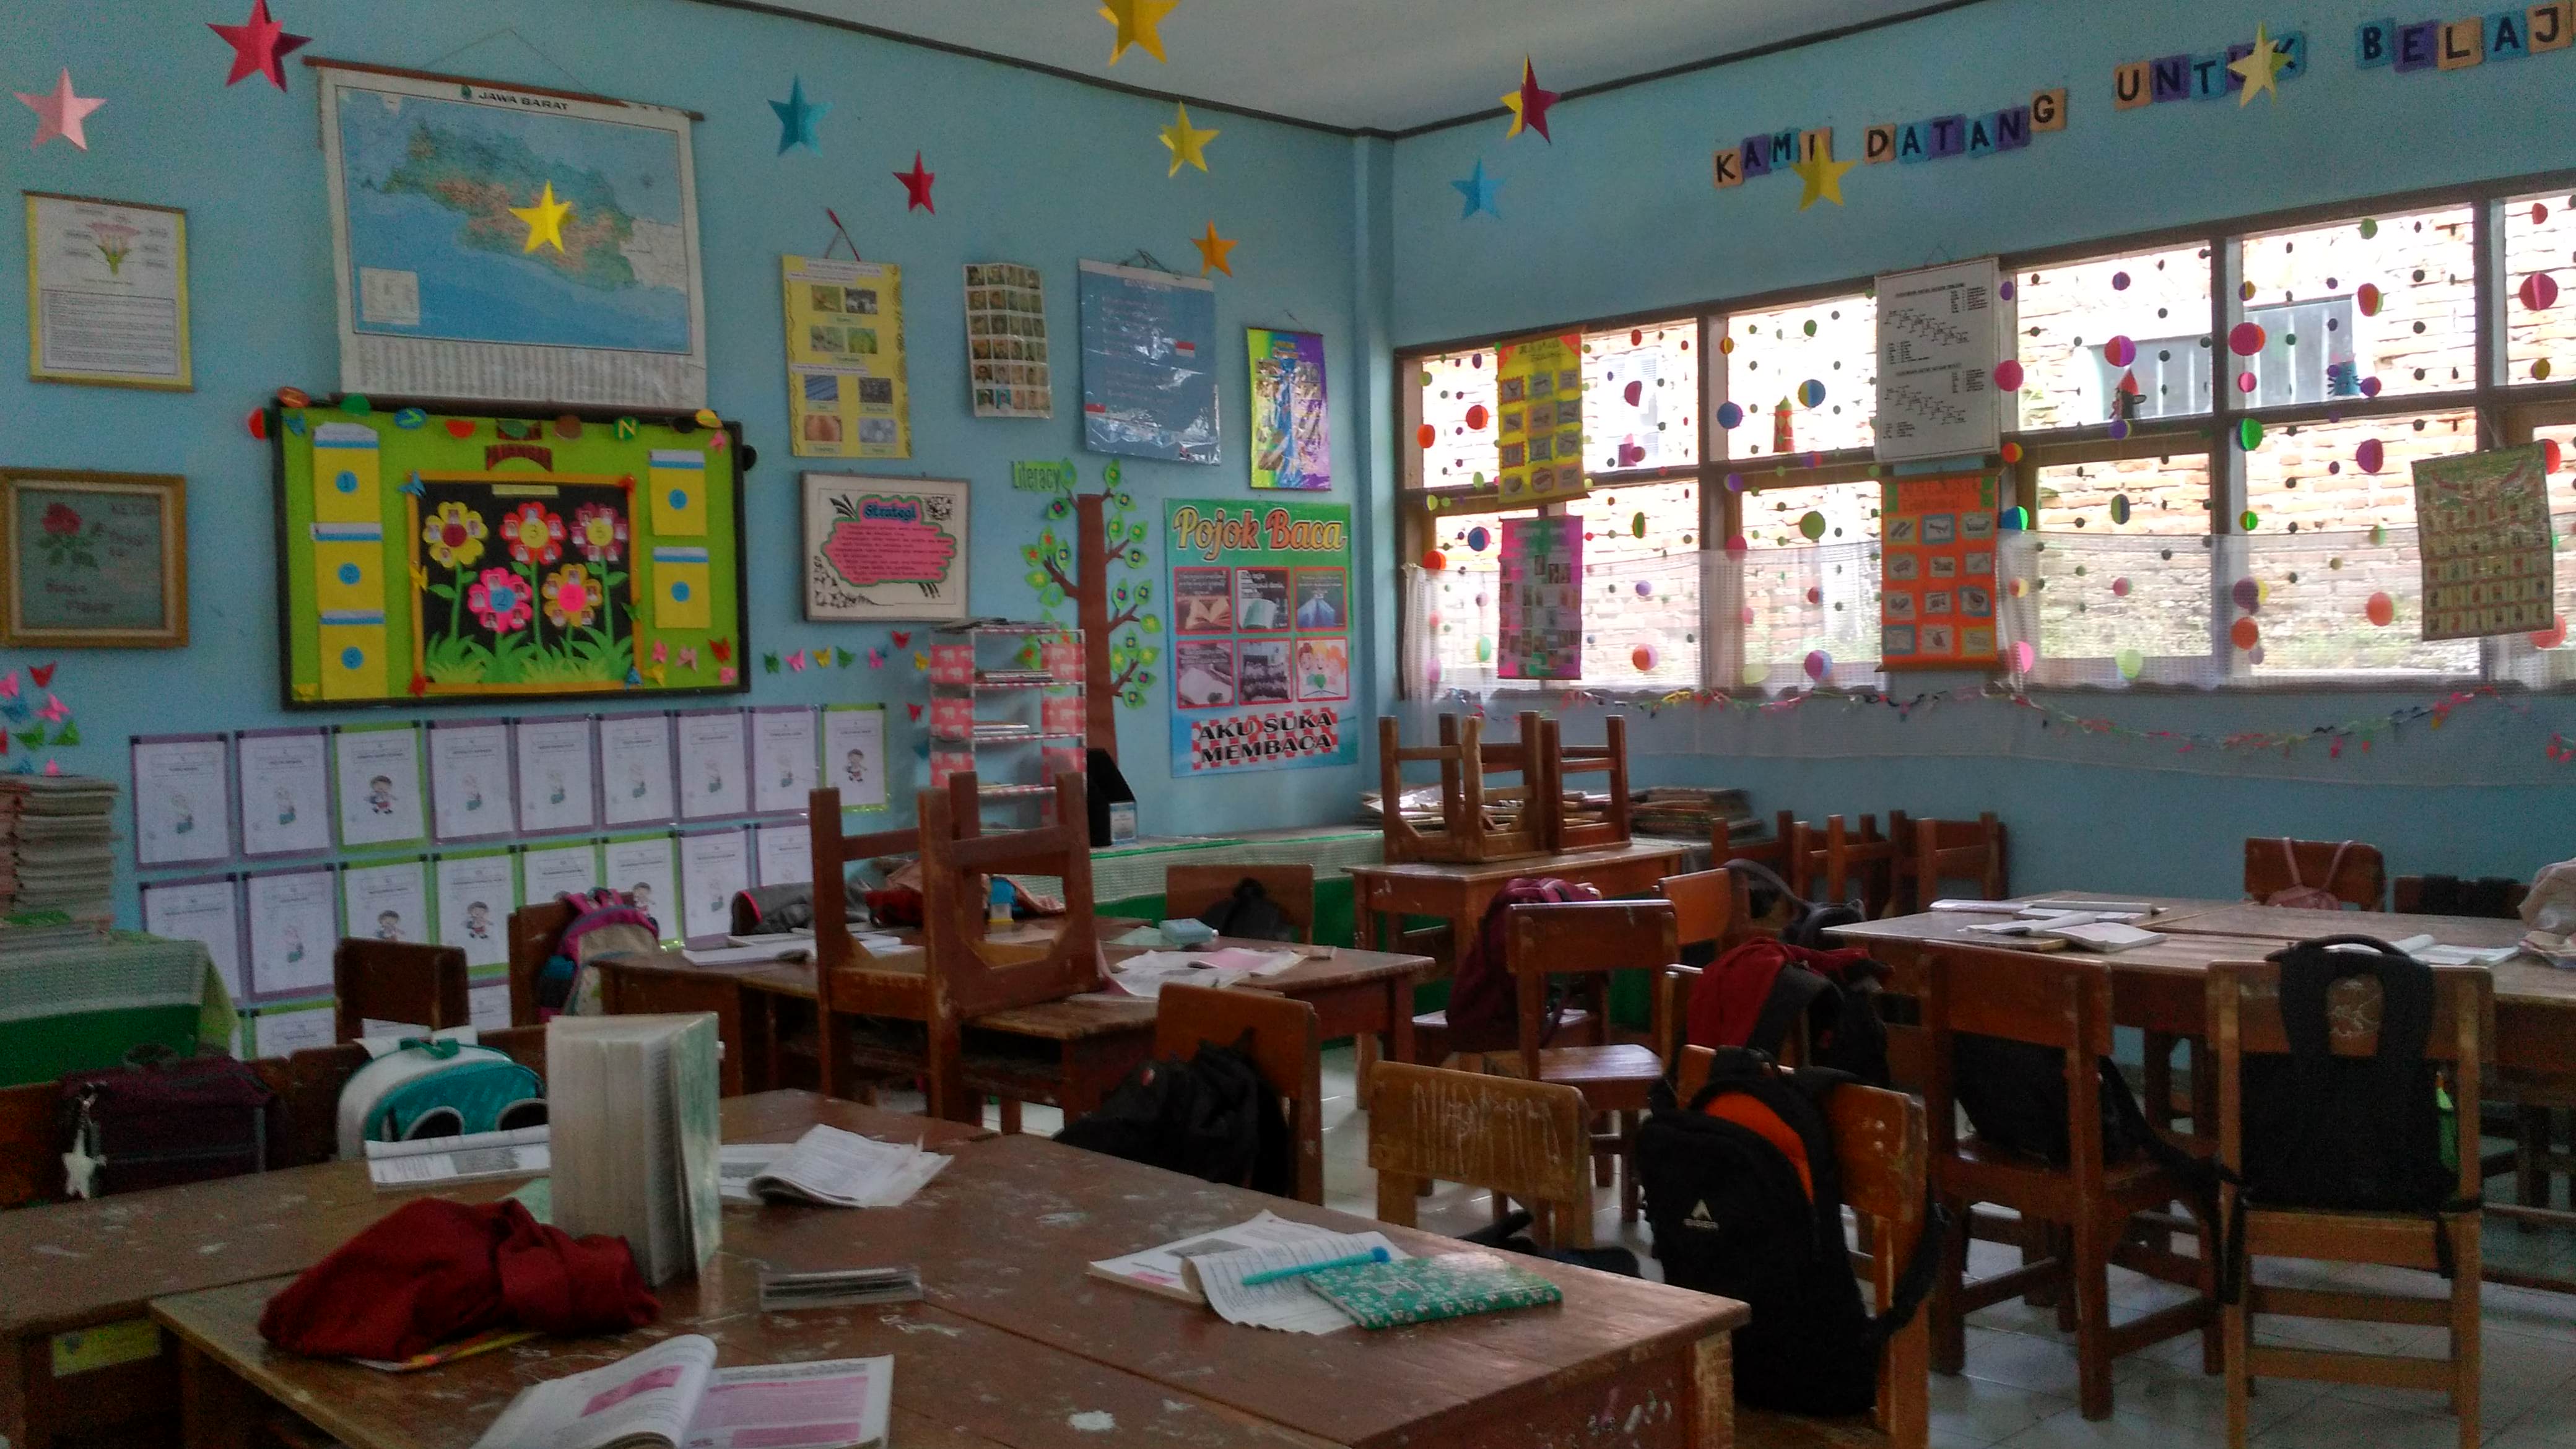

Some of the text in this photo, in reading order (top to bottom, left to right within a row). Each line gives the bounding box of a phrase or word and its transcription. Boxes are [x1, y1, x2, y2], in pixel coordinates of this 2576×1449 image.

[479, 92, 568, 110] JAWA BARAT
[1716, 133, 1817, 183] KAMI
[1867, 95, 2053, 158] DATANG
[2362, 6, 2559, 63] BELAJ
[1011, 460, 1060, 493] Literacy
[1173, 506, 1347, 561] Pojok Baca
[1199, 713, 1332, 741] AKU SUKA
[1201, 734, 1331, 763] MEMBACA
